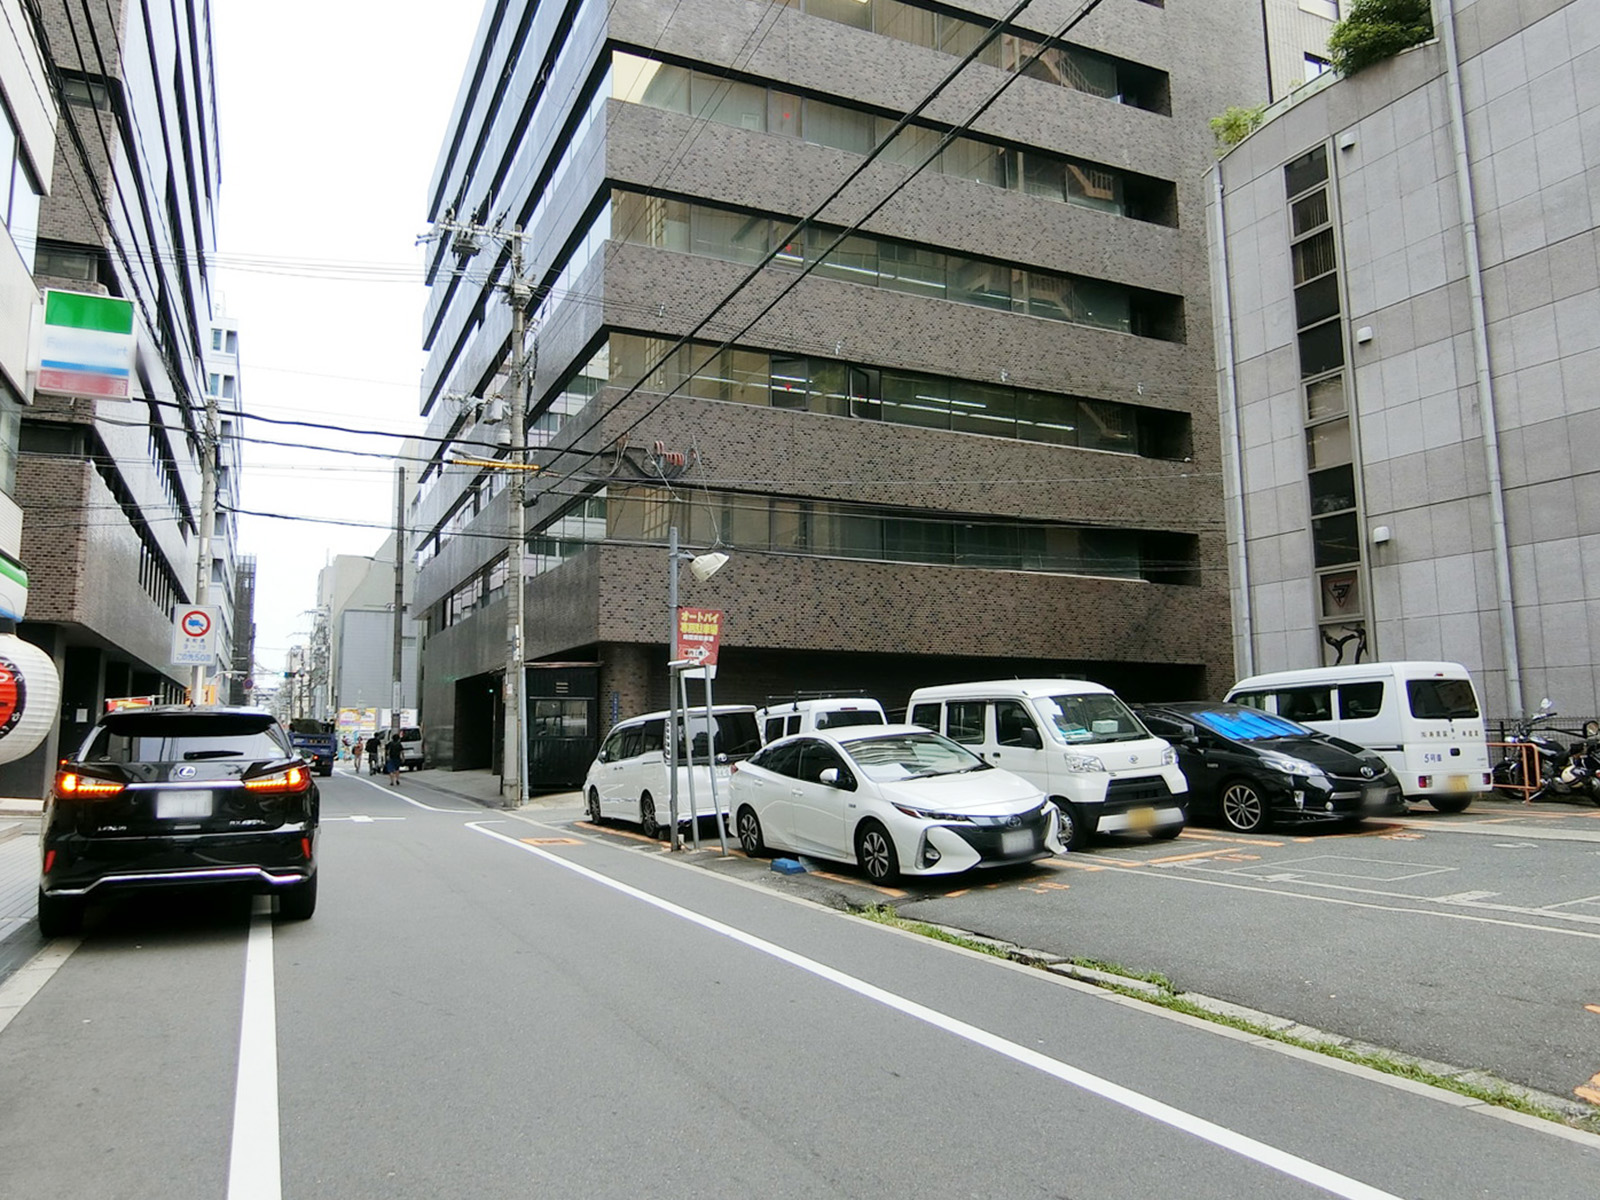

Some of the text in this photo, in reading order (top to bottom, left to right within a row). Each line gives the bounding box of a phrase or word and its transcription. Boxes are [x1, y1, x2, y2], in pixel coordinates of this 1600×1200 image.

[681, 611, 719, 623] オートバイ
